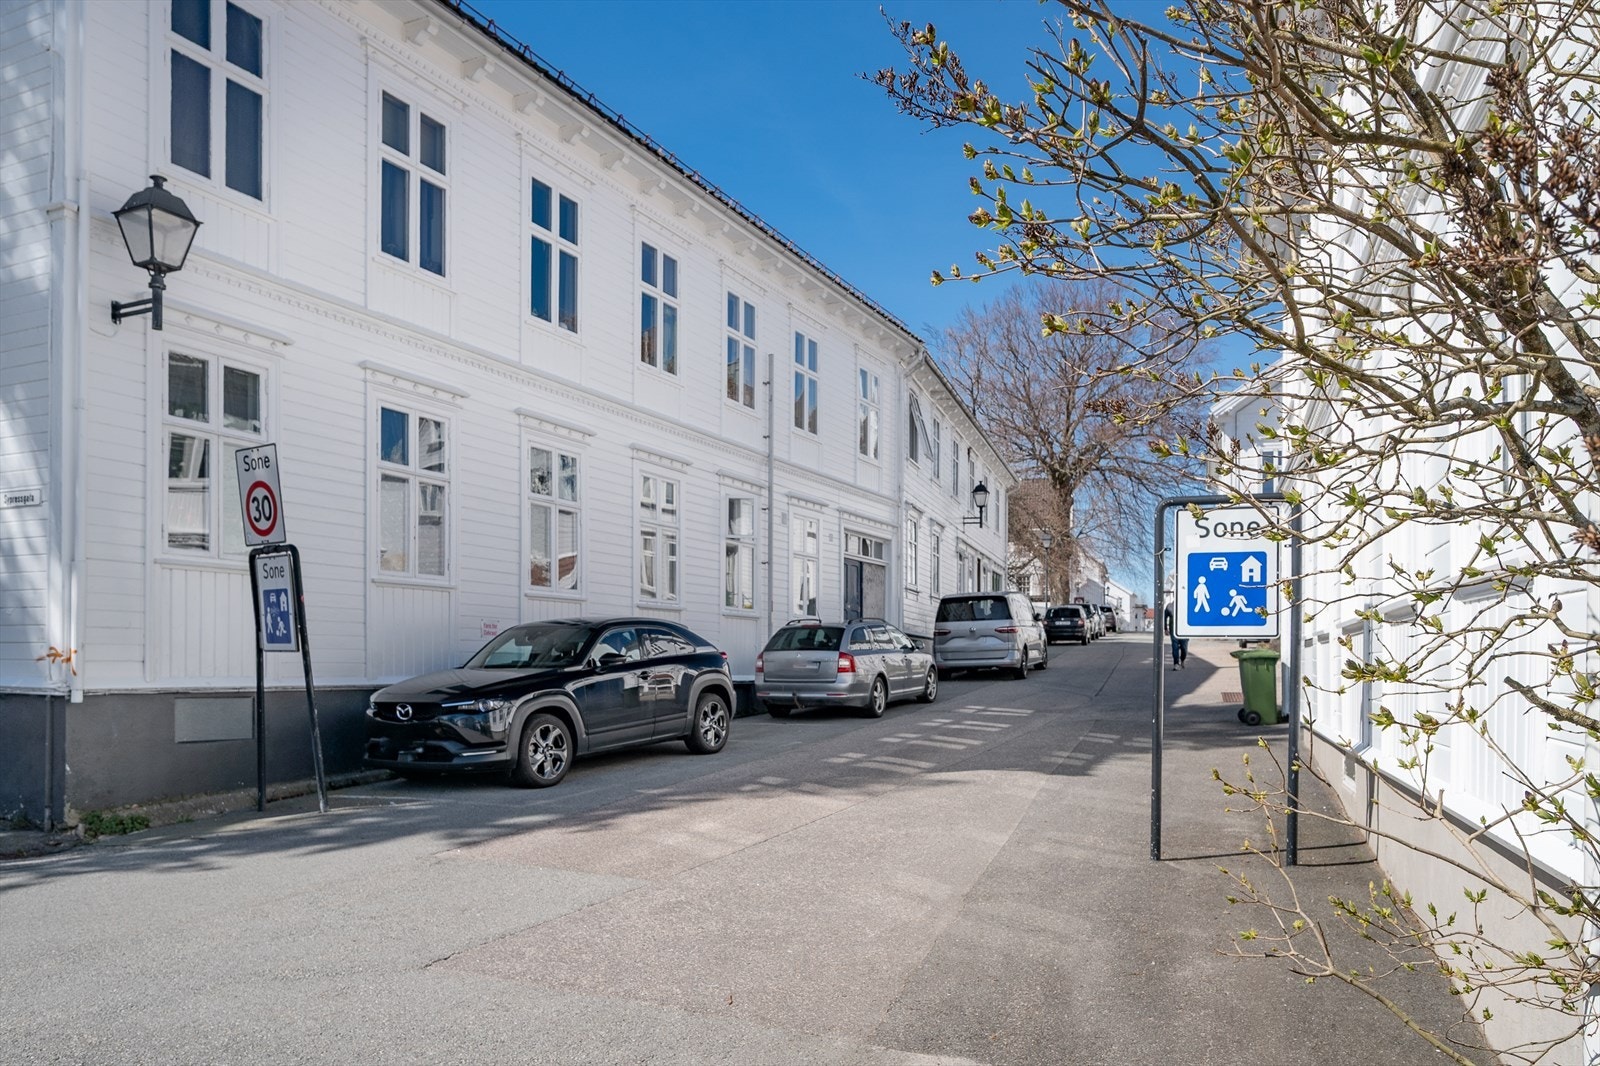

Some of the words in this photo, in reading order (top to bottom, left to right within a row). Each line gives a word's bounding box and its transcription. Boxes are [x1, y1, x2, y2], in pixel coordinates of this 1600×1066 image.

[243, 455, 270, 472] Sone
[252, 496, 272, 523] 30
[1195, 517, 1260, 538] Sone
[263, 563, 285, 579] Sone
